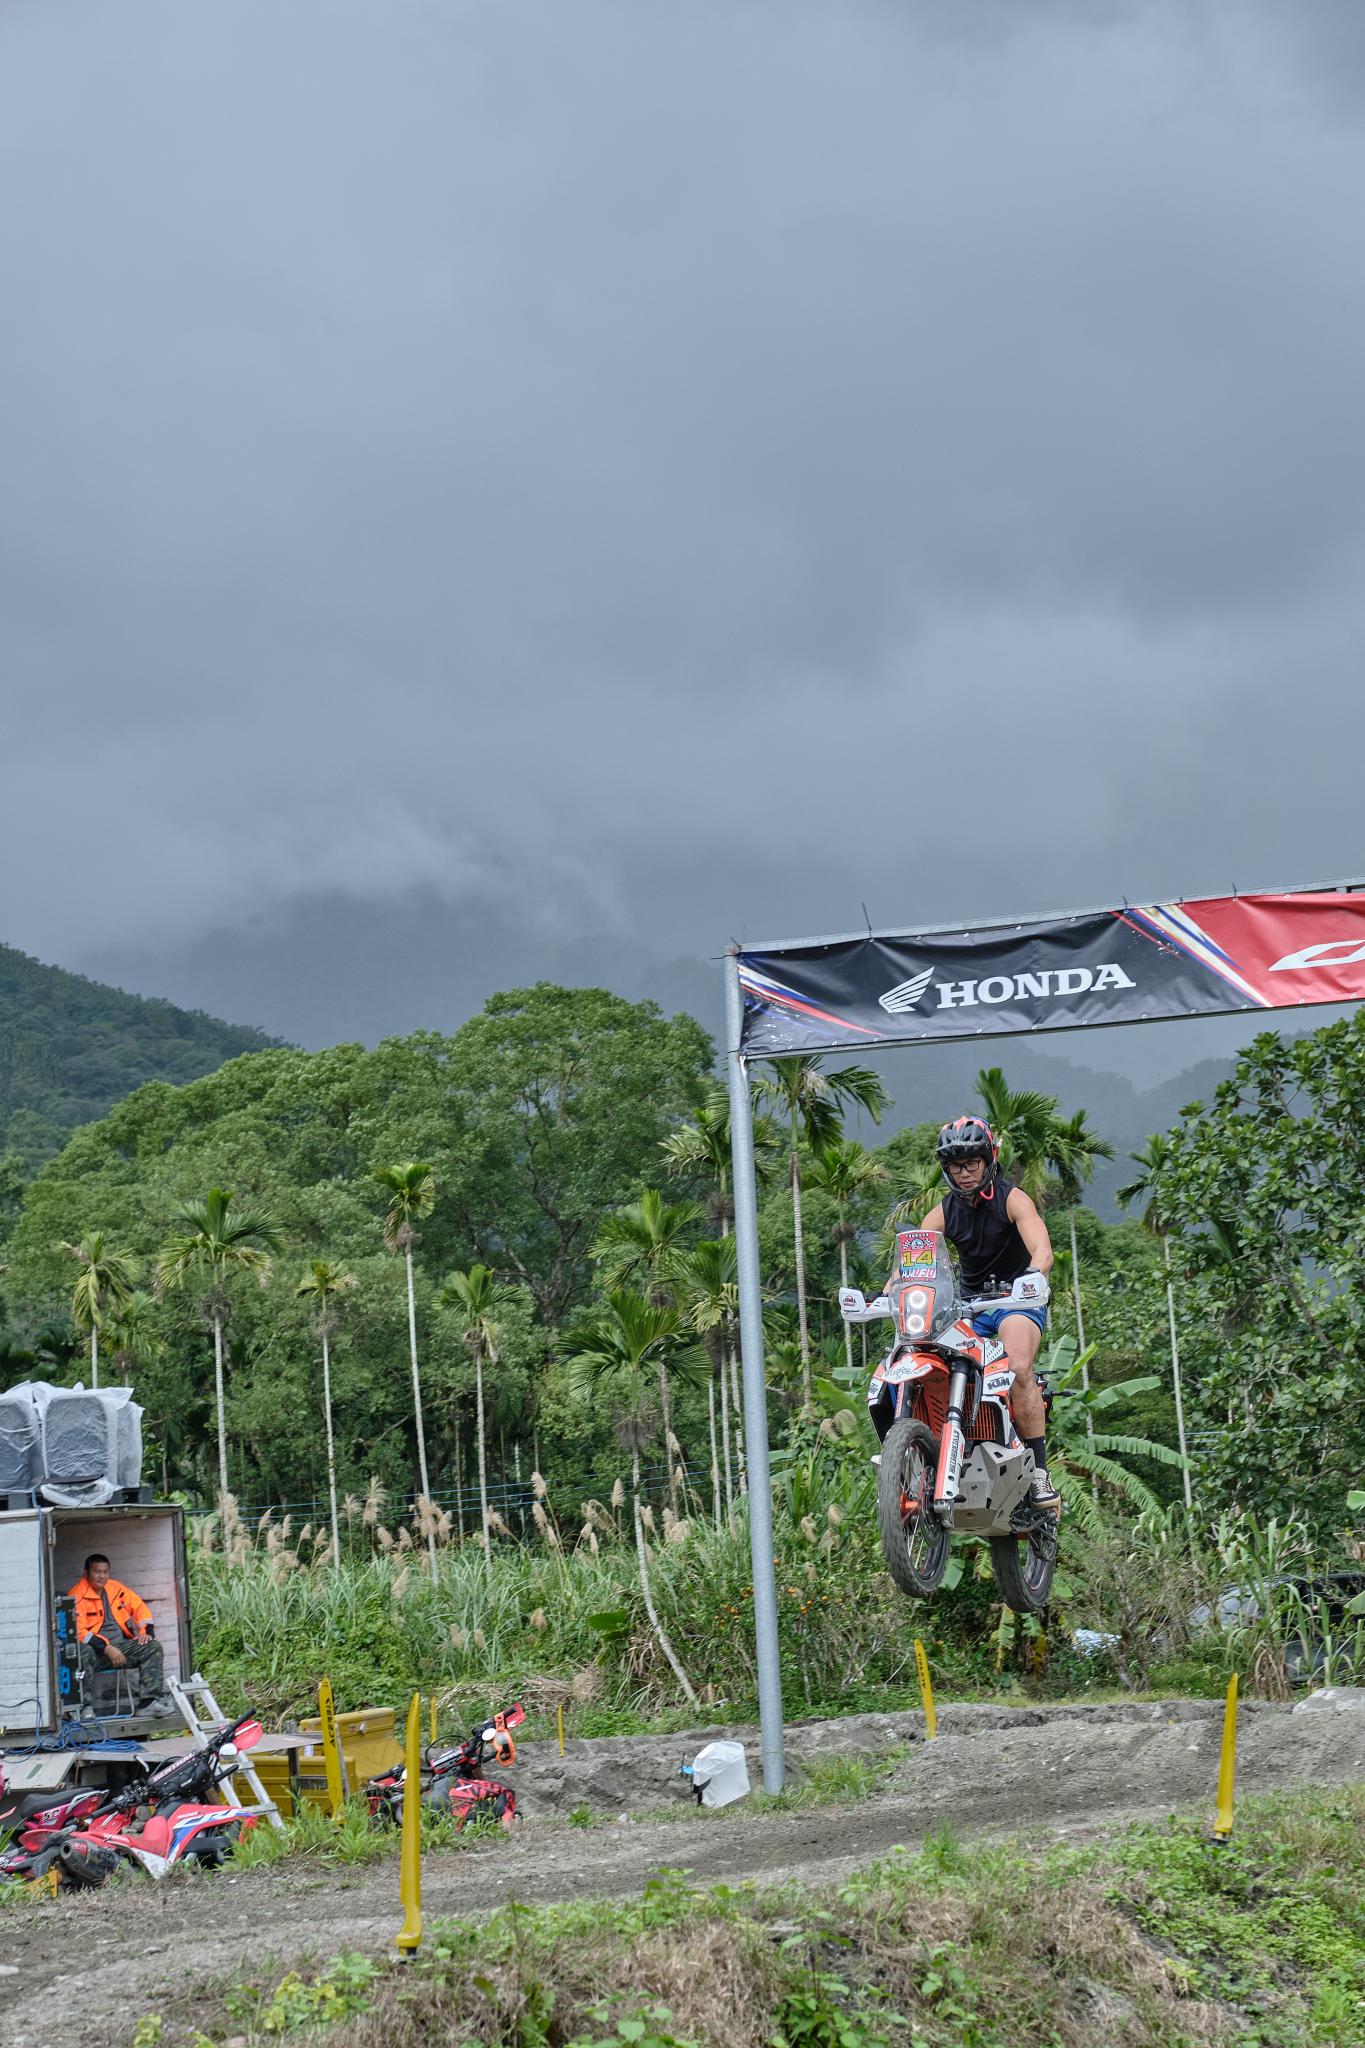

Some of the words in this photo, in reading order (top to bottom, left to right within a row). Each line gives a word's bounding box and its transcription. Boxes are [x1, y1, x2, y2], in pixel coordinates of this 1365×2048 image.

[1267, 939, 1365, 972] C
[935, 963, 1137, 1009] HONDA
[901, 1249, 934, 1267] 14
[987, 1376, 1010, 1391] KTM
